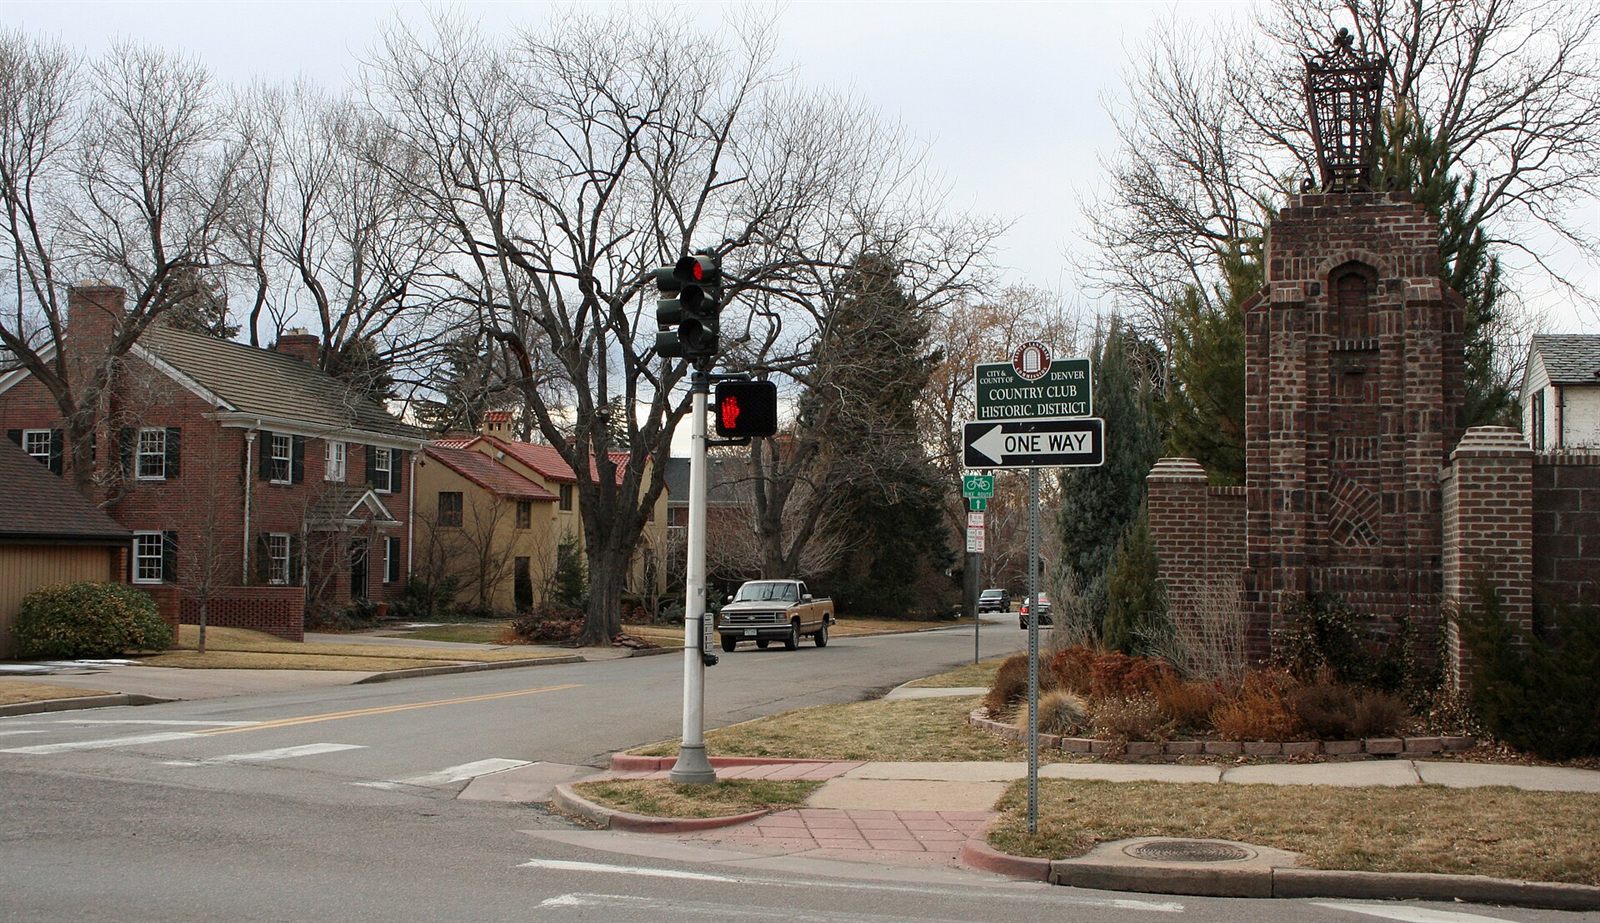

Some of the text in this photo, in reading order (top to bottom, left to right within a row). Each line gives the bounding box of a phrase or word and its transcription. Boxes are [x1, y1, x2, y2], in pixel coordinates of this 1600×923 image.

[979, 377, 1003, 385] COUNTY
[1051, 371, 1085, 381] DENVER
[989, 385, 1077, 401] COUNTRY CLUB
[1037, 402, 1086, 416] DISTRICT
[1004, 434, 1087, 453] ONE WAY
